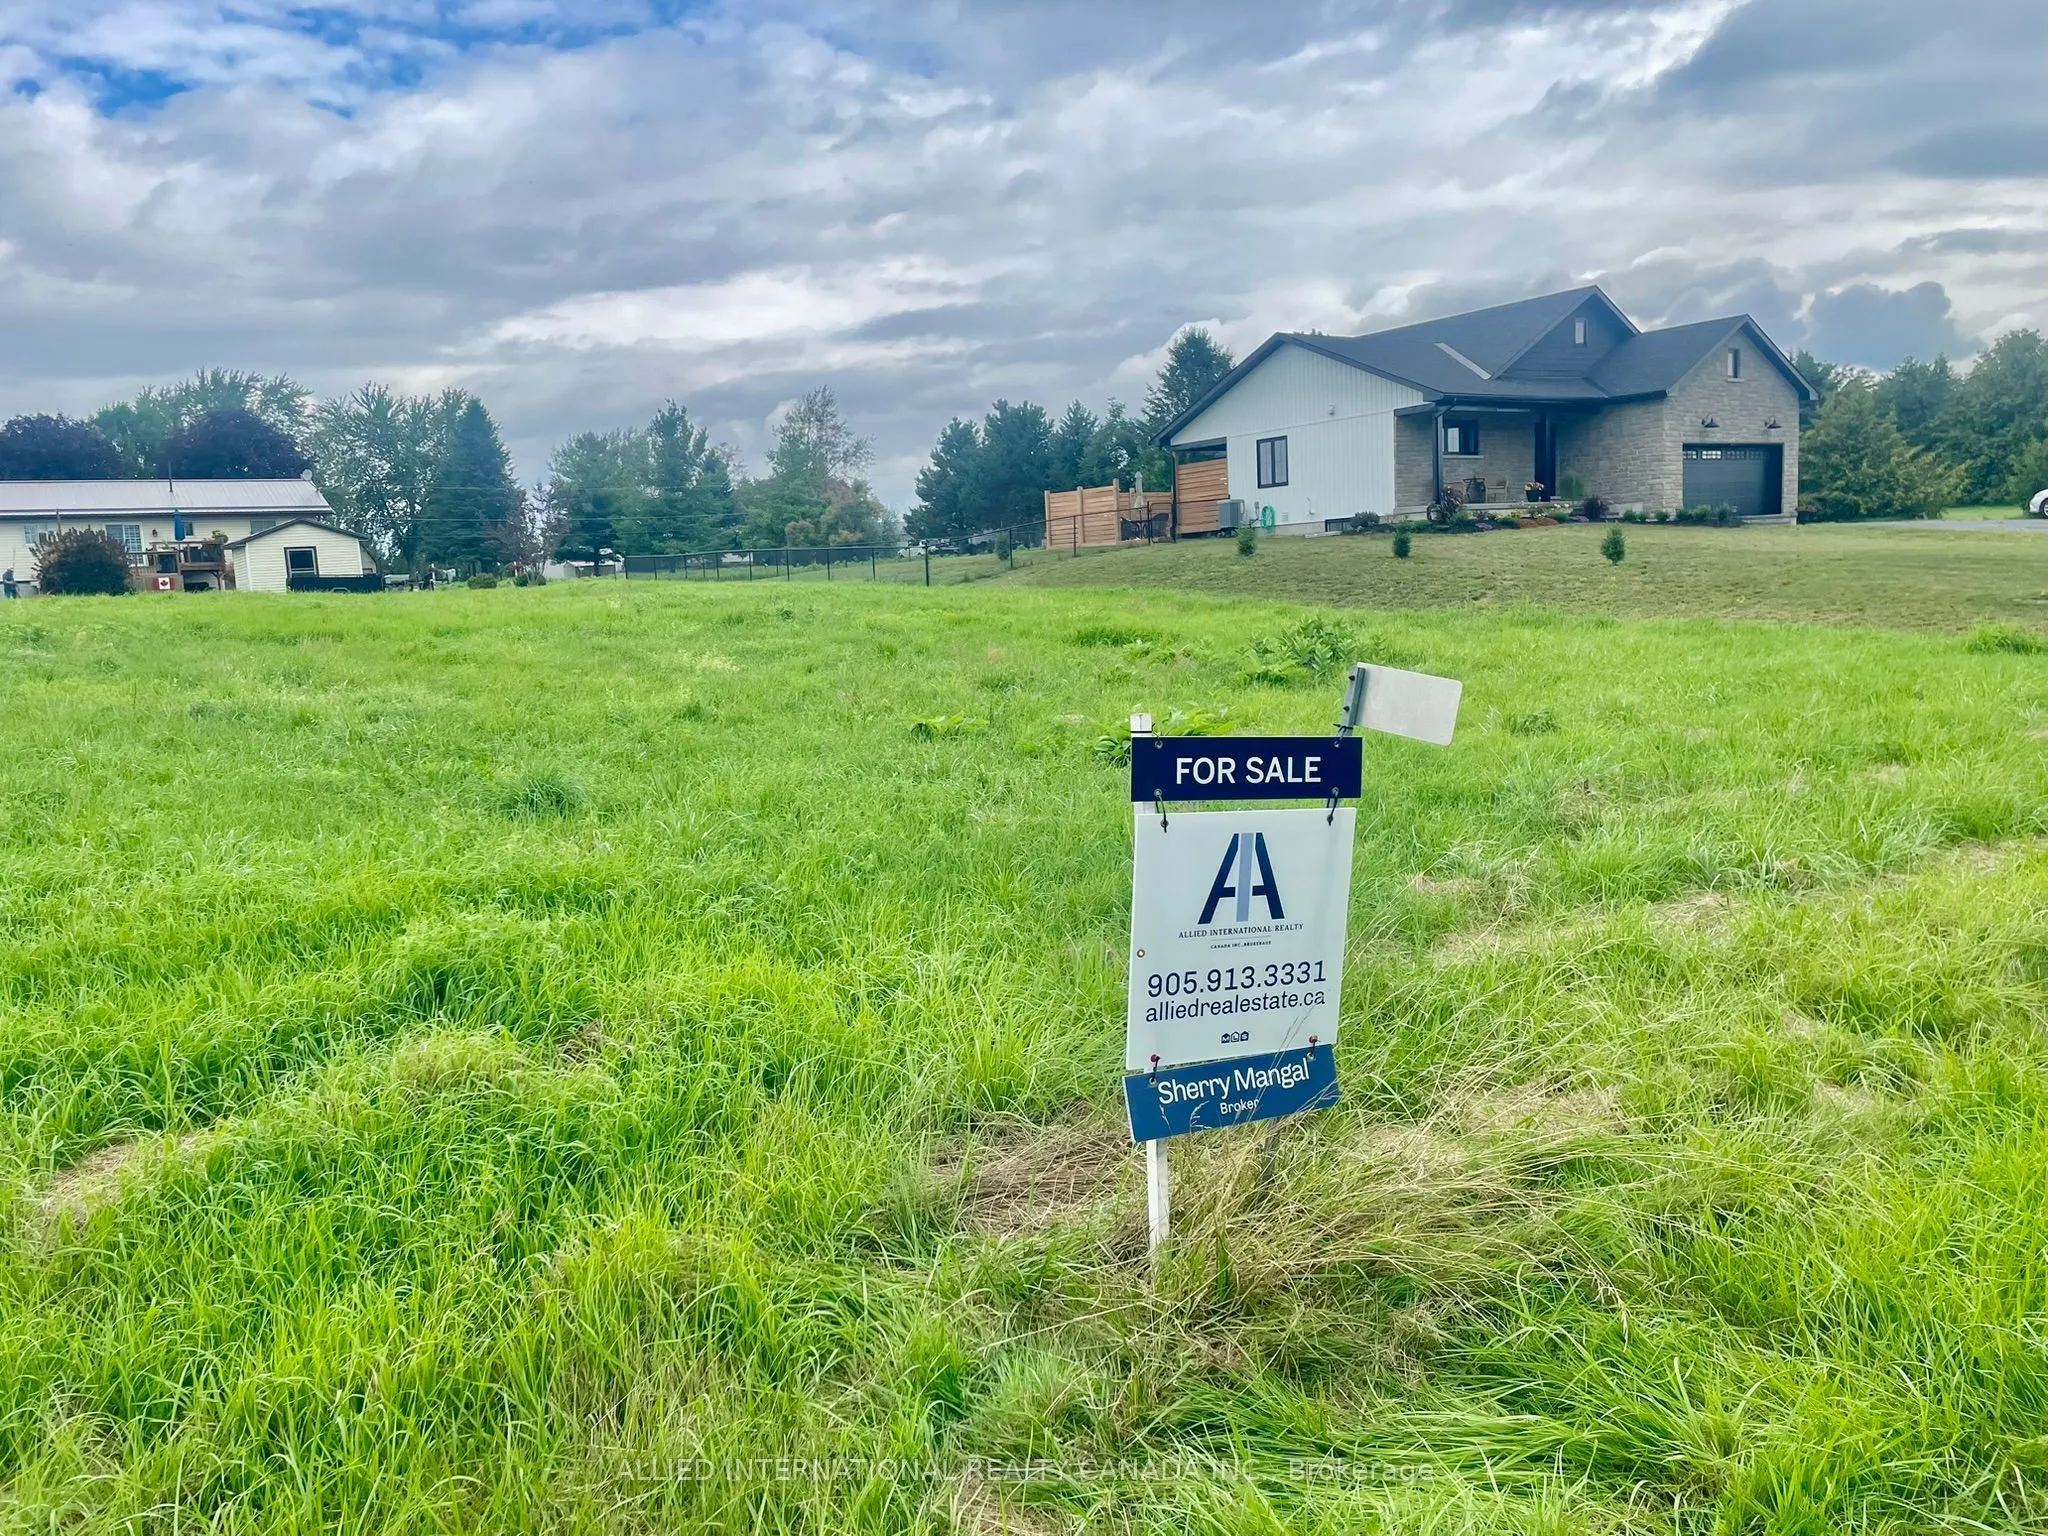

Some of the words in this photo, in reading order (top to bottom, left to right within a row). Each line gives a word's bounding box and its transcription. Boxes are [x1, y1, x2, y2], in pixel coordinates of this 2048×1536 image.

[1176, 757, 1236, 785] FOR
[1245, 756, 1322, 784] SALE
[1178, 929, 1208, 939] ALLIED
[1209, 924, 1273, 937] INTERNATIONAL
[1274, 923, 1304, 932] REALTY
[1147, 960, 1327, 998] 905.913.3331
[1145, 991, 1326, 1023] alliedrealestate.ca
[1158, 1076, 1230, 1104] Sherry
[1233, 1057, 1310, 1089] Mangal
[1219, 1098, 1260, 1115] Broker
